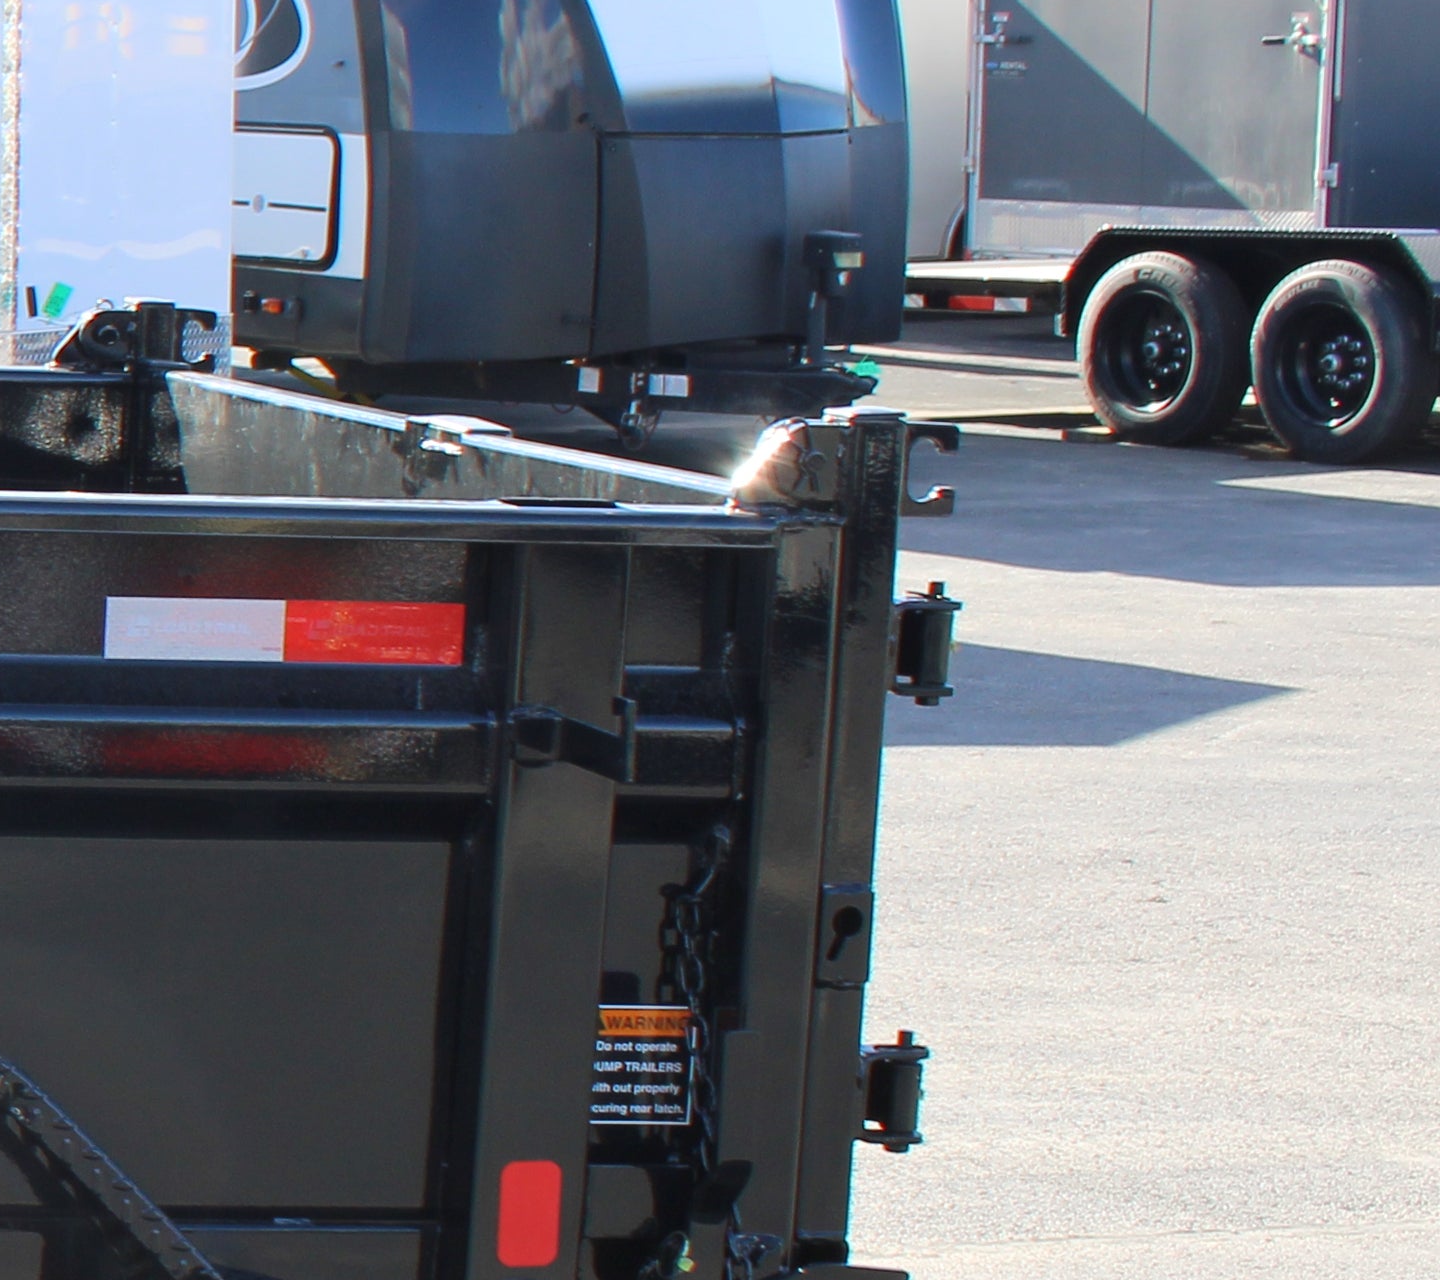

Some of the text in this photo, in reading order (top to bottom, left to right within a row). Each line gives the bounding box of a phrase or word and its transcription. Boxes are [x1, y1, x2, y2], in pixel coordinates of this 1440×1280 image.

[596, 1041, 678, 1055] Do not operate
[594, 1062, 683, 1073] UMP TRAILERS
[612, 1083, 632, 1093] out
[633, 1083, 680, 1096] properly
[591, 1103, 684, 1116] curing rear latch.
